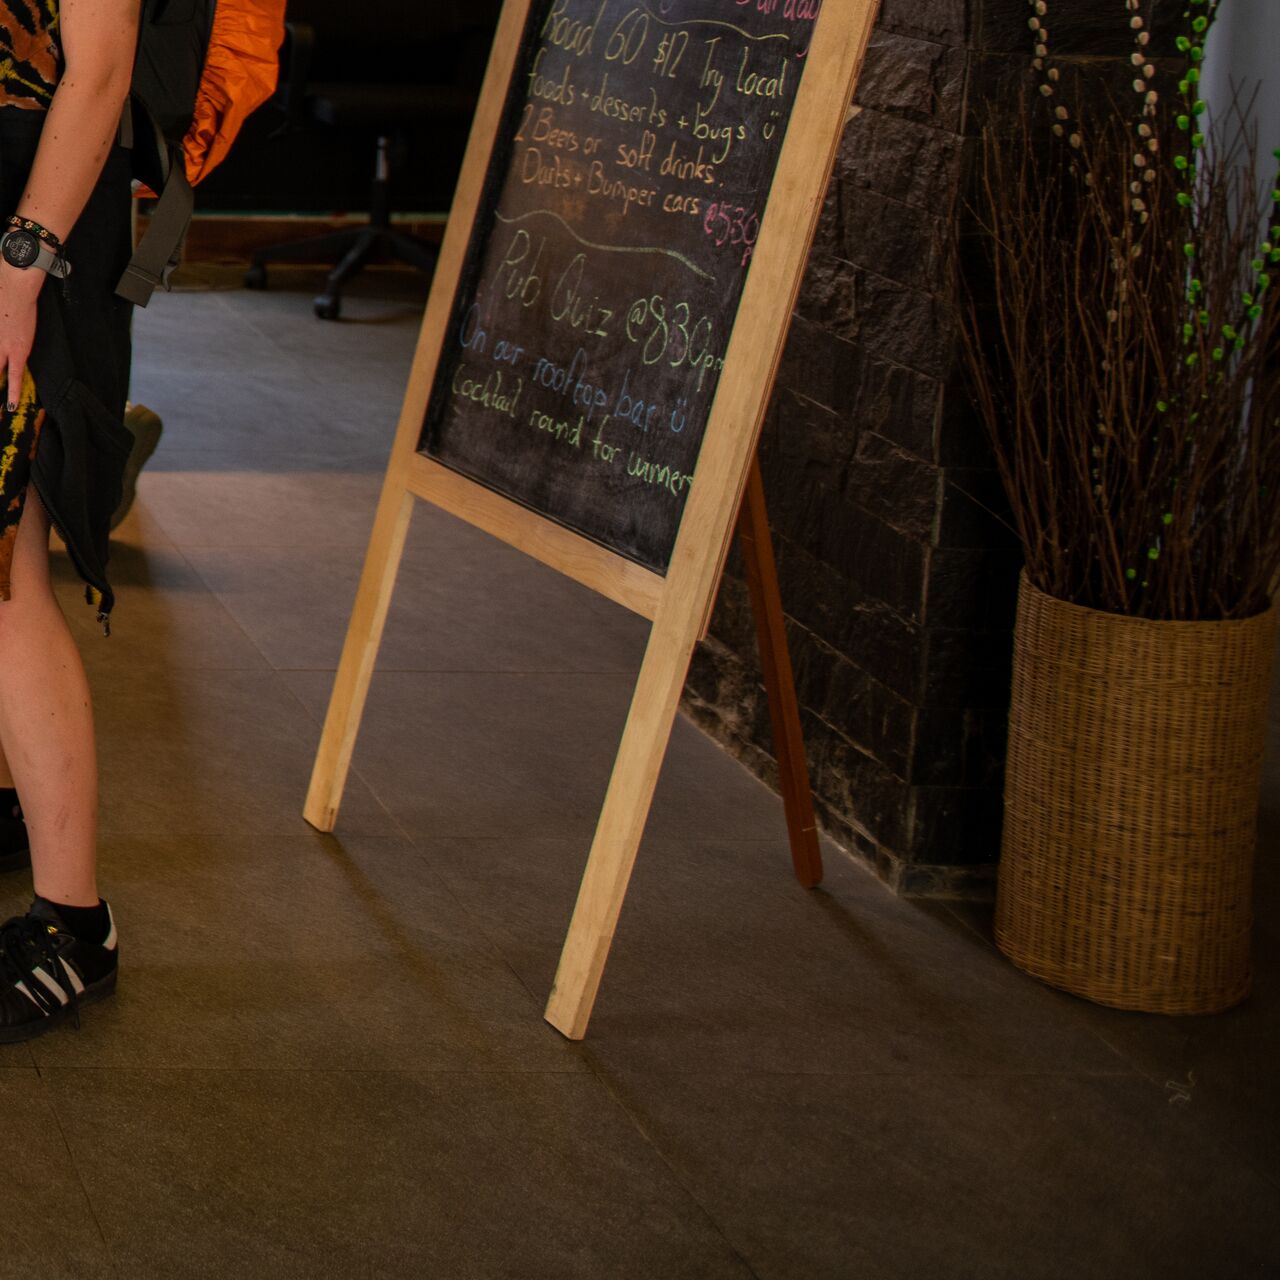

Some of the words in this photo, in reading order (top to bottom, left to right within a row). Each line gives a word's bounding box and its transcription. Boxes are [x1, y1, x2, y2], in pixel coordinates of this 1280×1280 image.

[527, 47, 575, 106] foods
[591, 72, 668, 128] desserts
[692, 101, 747, 165] bugs
[604, 7, 650, 65] 60
[652, 30, 689, 78] $12
[698, 36, 724, 117] Try
[532, 106, 580, 152] Beers
[583, 136, 604, 155] or
[615, 129, 656, 171] soft
[589, 160, 657, 215] Bumper
[662, 192, 700, 215] cars
[490, 228, 547, 307] Pub
[550, 252, 613, 338] Quiz
[459, 303, 487, 353] On
[493, 340, 525, 366] our
[532, 347, 609, 422] rooftop
[614, 369, 657, 432] bar
[529, 410, 584, 449] round
[591, 413, 622, 464] for
